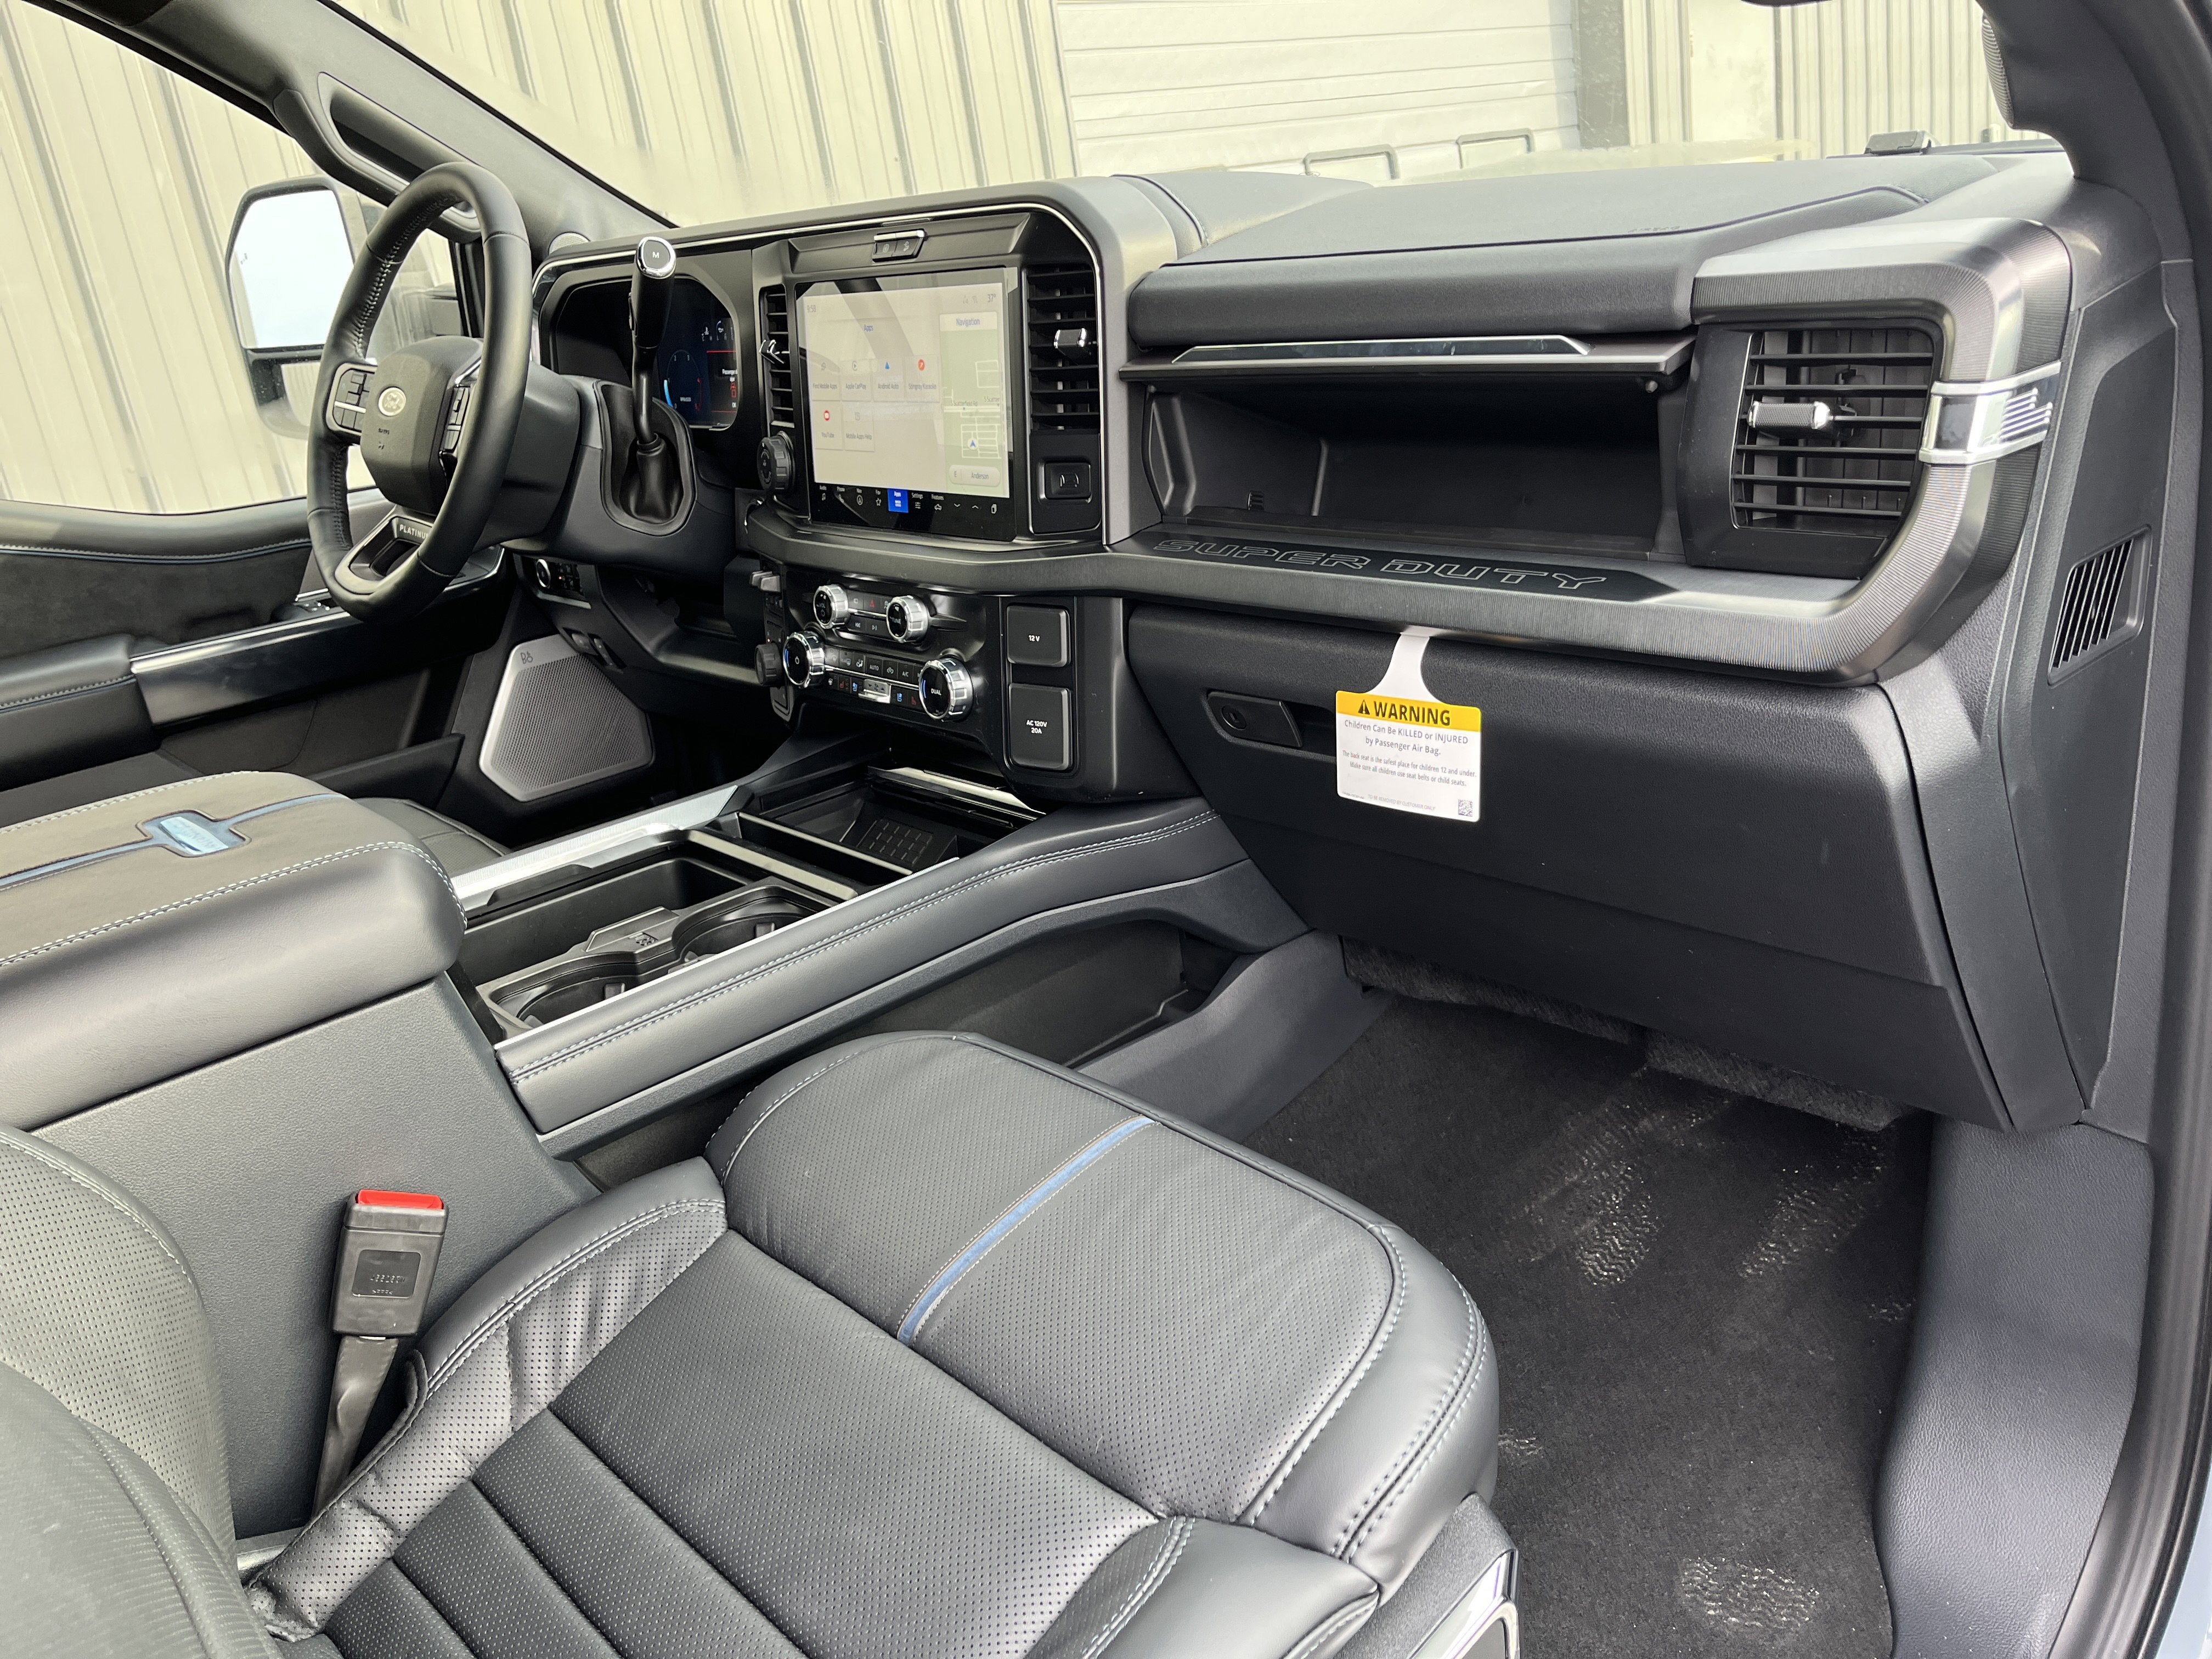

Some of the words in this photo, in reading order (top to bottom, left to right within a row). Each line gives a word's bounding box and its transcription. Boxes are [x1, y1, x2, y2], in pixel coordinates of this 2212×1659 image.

[988, 294, 996, 303] 37°
[806, 304, 816, 313] 9:58
[864, 324, 874, 332] Apps
[956, 318, 980, 327] Navigation
[399, 524, 428, 539] PLATINU
[1153, 539, 1371, 569] SUPER
[1380, 558, 1607, 590] DUTY
[930, 688, 942, 696] DUAL
[1373, 701, 1451, 726] WARNING
[1344, 719, 1371, 731] Children
[1373, 724, 1386, 733] Can
[1387, 726, 1396, 735] Be
[1398, 728, 1423, 738] KILLED
[1435, 733, 1468, 744] INJURED
[1365, 736, 1374, 747] by
[1375, 738, 1410, 752] Passenger
[1412, 744, 1423, 752] Air
[1425, 746, 1441, 757] Bag.
[1350, 752, 1360, 760] back
[1419, 763, 1440, 772] children
[1459, 769, 1477, 777] under.
[1350, 761, 1361, 769] Make
[1378, 766, 1396, 776] children
[1417, 773, 1430, 781] belts
[1437, 776, 1450, 785] child
[1379, 796, 1396, 804] REMOVED
